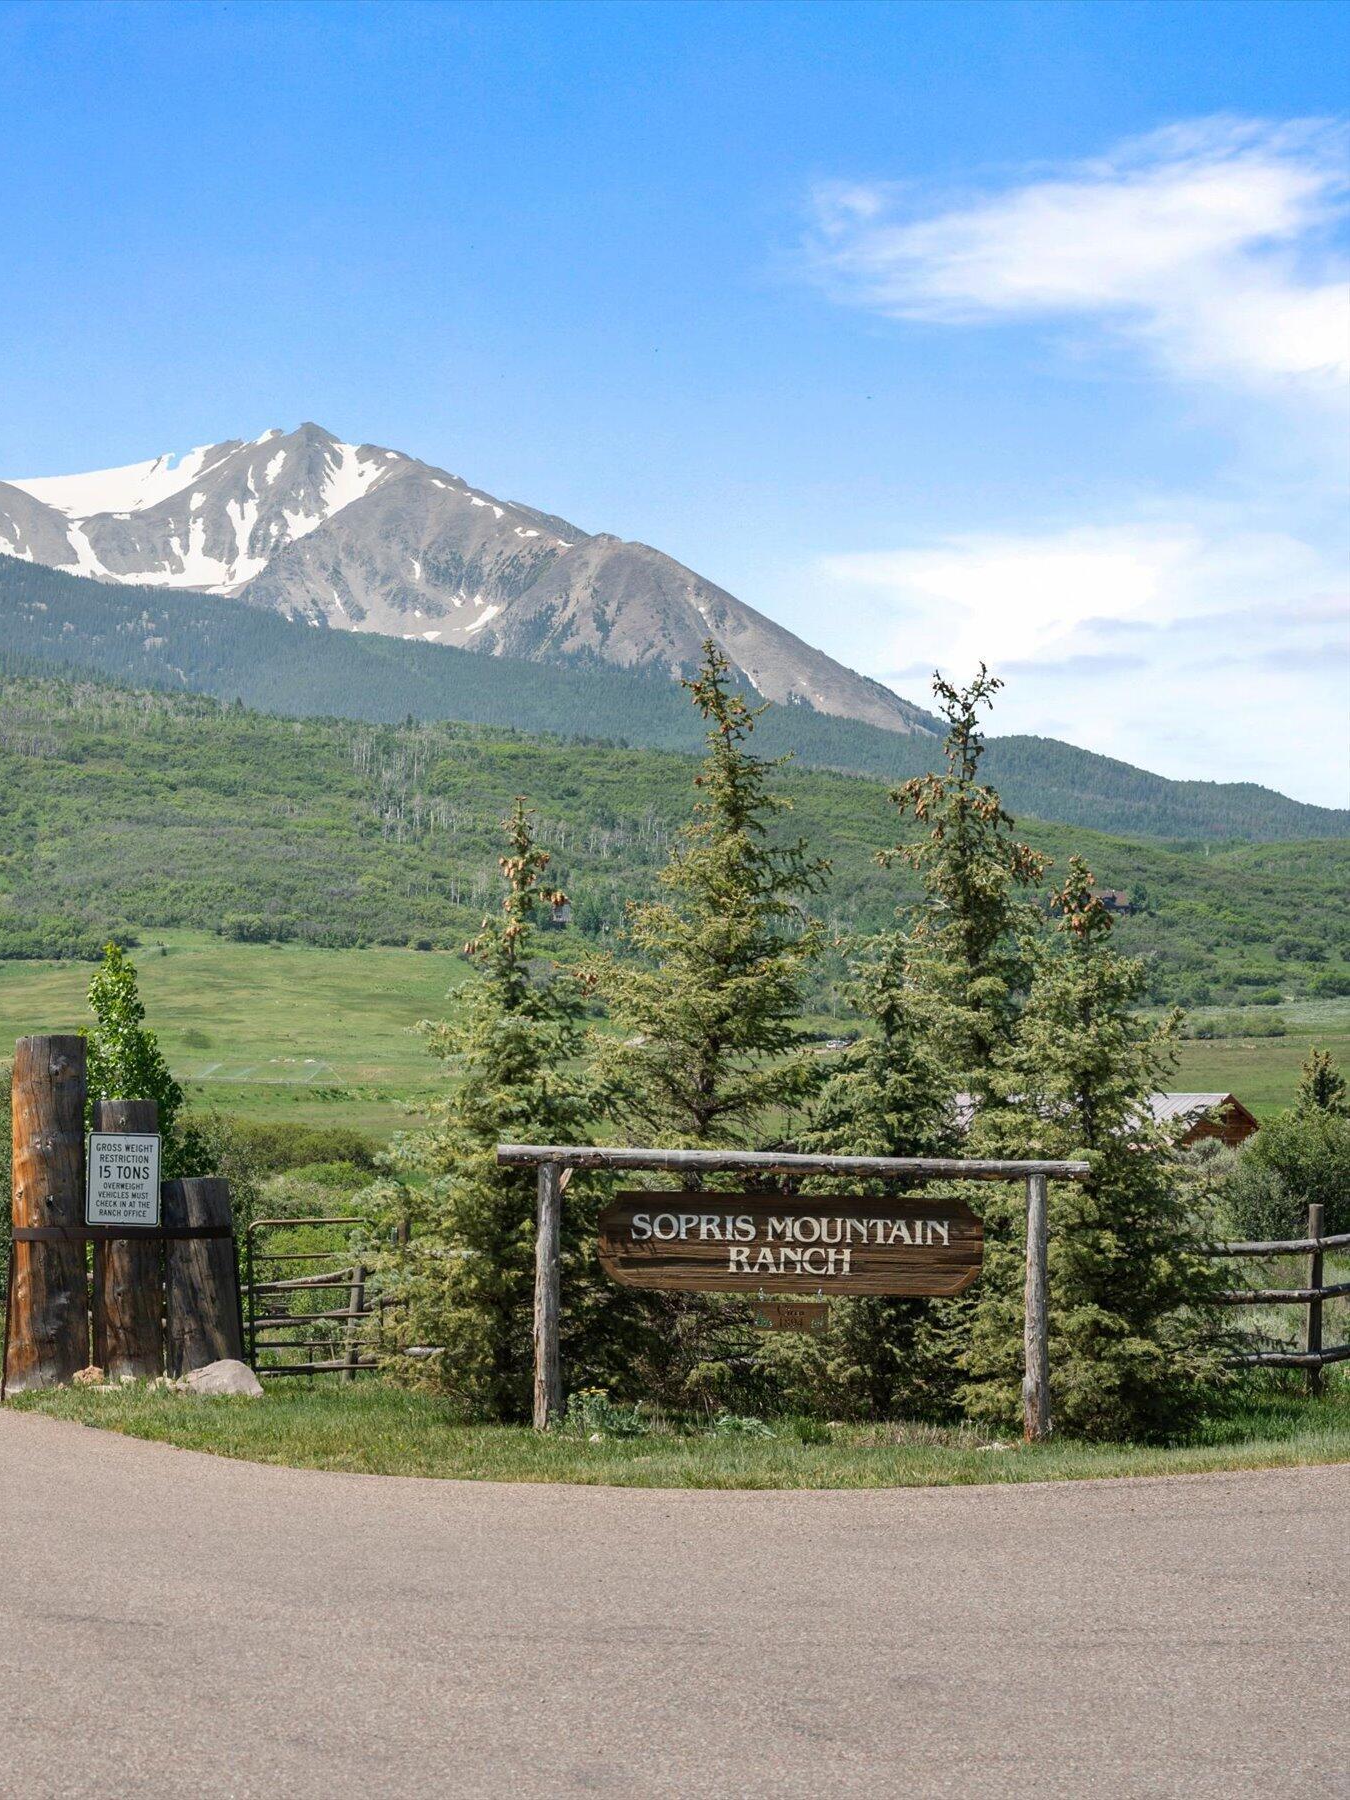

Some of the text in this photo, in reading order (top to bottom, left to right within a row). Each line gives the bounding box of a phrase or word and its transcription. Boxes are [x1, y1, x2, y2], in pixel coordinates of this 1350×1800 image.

[96, 1143, 153, 1153] GROSS WEIGHT
[100, 1154, 149, 1163] RESTRICTION
[99, 1165, 150, 1179] 15 TONS
[103, 1182, 144, 1190] OVERWEIGHT
[98, 1191, 149, 1200] VEHICLES MUST
[138, 1201, 150, 1209] THE
[99, 1209, 147, 1218] RANCH OFFICE
[631, 1213, 950, 1246] SOPRIS MOUNTAIN
[728, 1247, 853, 1276] RANCH
